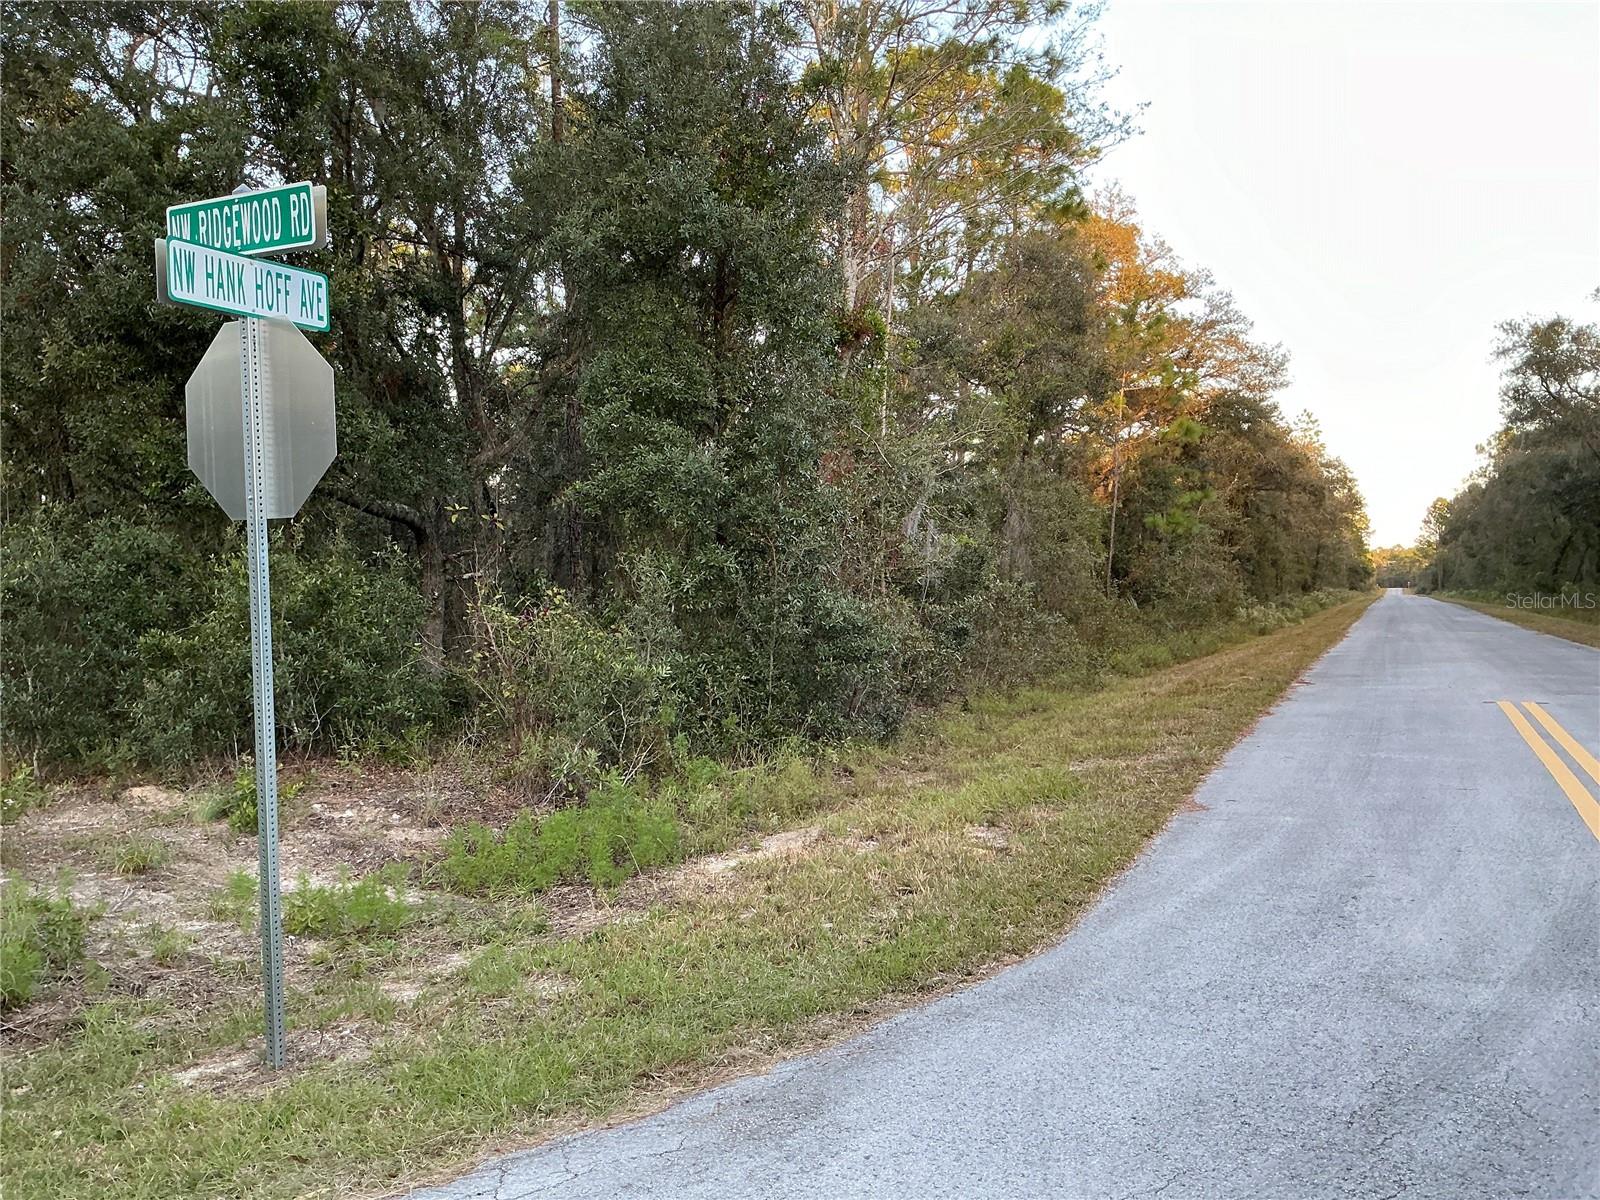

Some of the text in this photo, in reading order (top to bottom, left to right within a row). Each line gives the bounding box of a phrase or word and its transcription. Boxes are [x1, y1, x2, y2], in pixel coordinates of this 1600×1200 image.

[171, 192, 310, 249] NW RIDGEWOOD RD
[173, 246, 324, 322] NW HANK HOFF AVE
